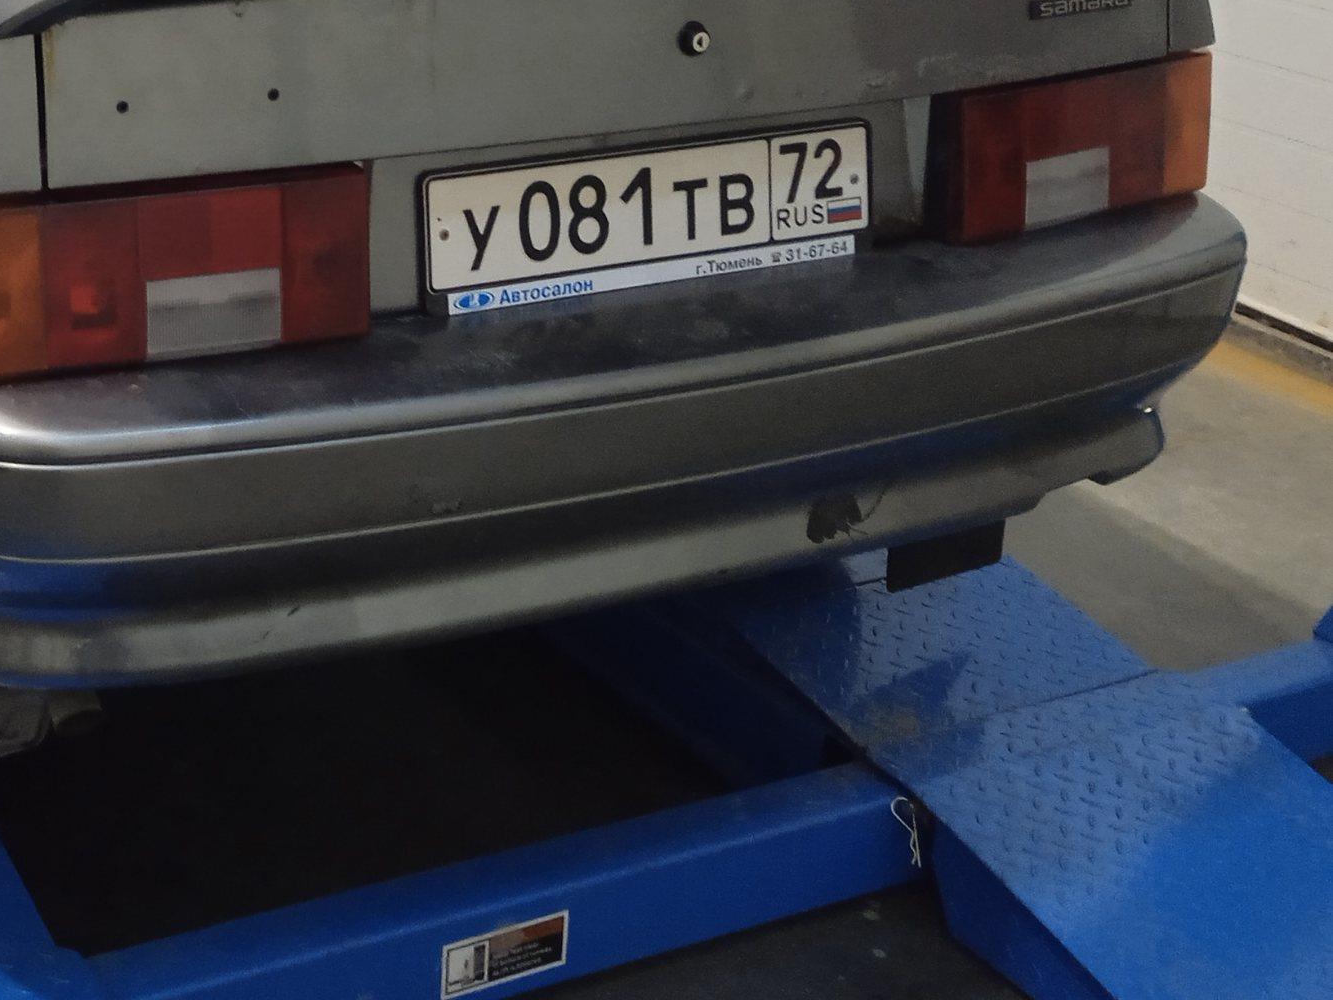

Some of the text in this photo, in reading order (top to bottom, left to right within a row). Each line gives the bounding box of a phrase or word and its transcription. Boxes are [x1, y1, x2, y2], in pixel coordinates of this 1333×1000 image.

[779, 139, 844, 204] 72
[777, 205, 825, 231] RUS
[785, 241, 848, 262] 31-67-64
[499, 279, 593, 305] Автосалон
